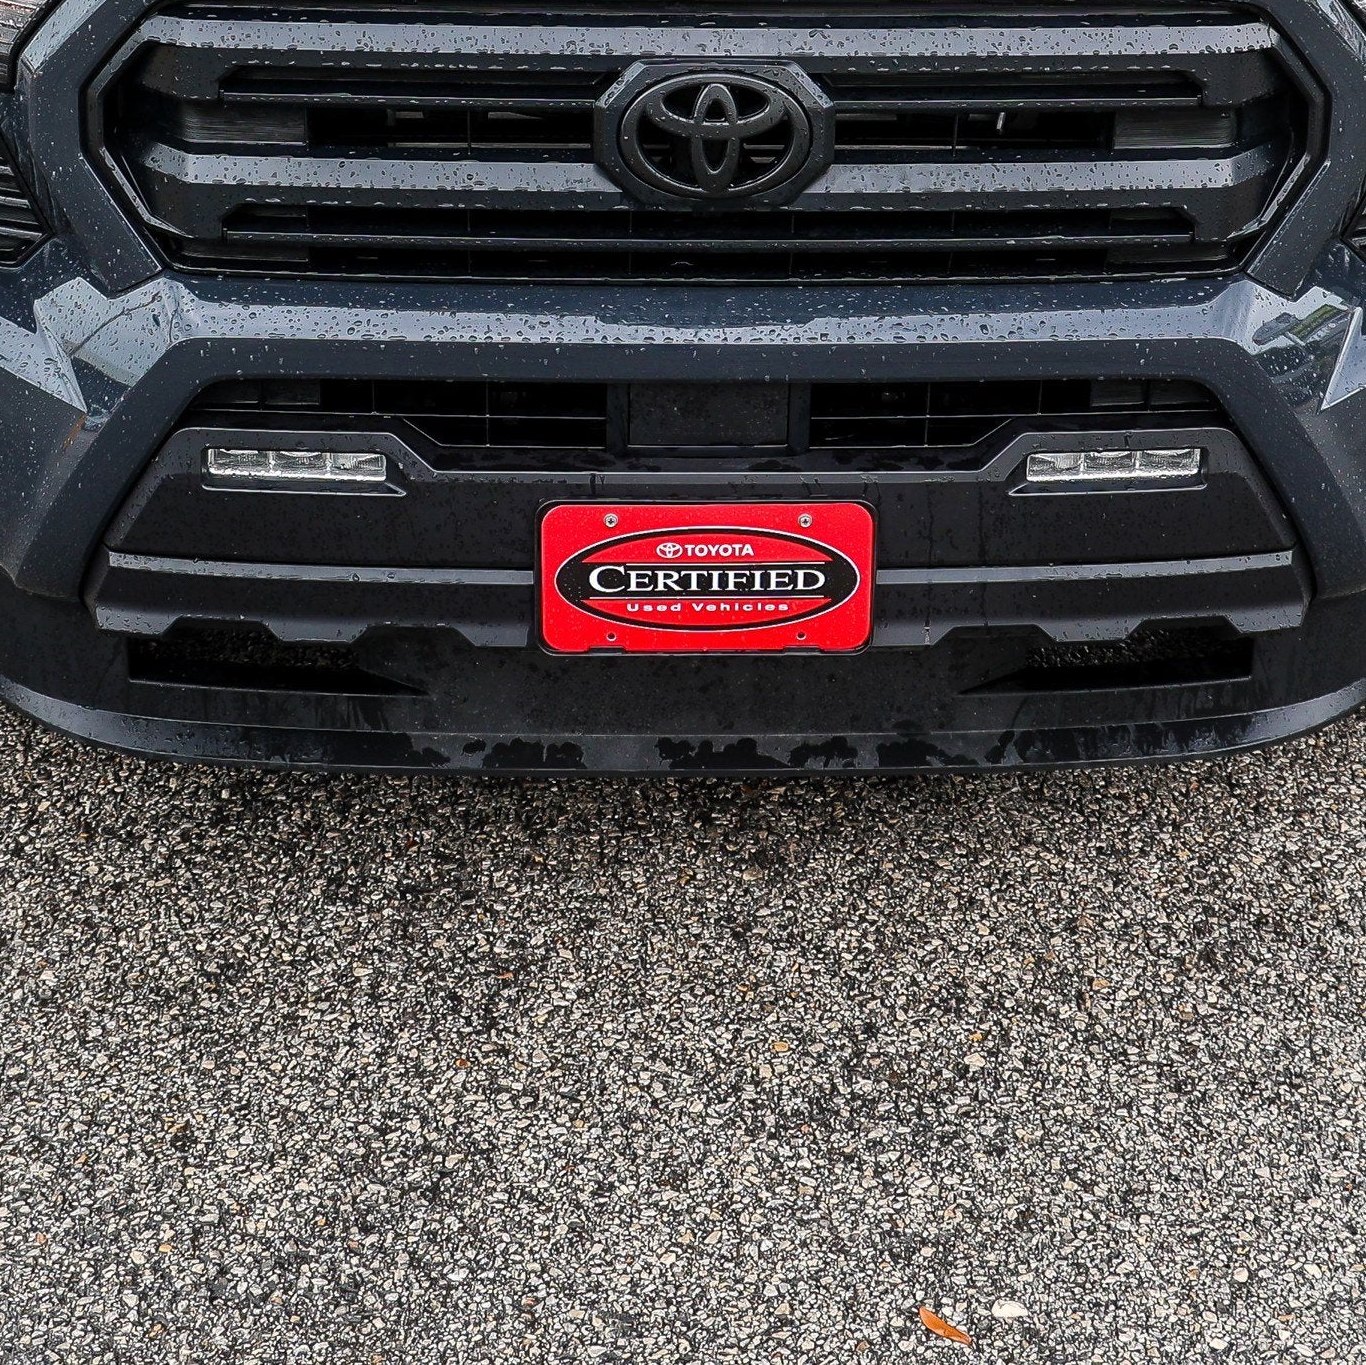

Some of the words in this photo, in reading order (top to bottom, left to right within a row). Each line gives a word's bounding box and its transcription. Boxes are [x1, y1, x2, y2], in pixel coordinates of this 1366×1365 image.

[685, 543, 755, 557] TOYOTA
[588, 565, 826, 593] CERTIFIED
[626, 602, 682, 613] Used
[691, 602, 790, 613] Vehicles
